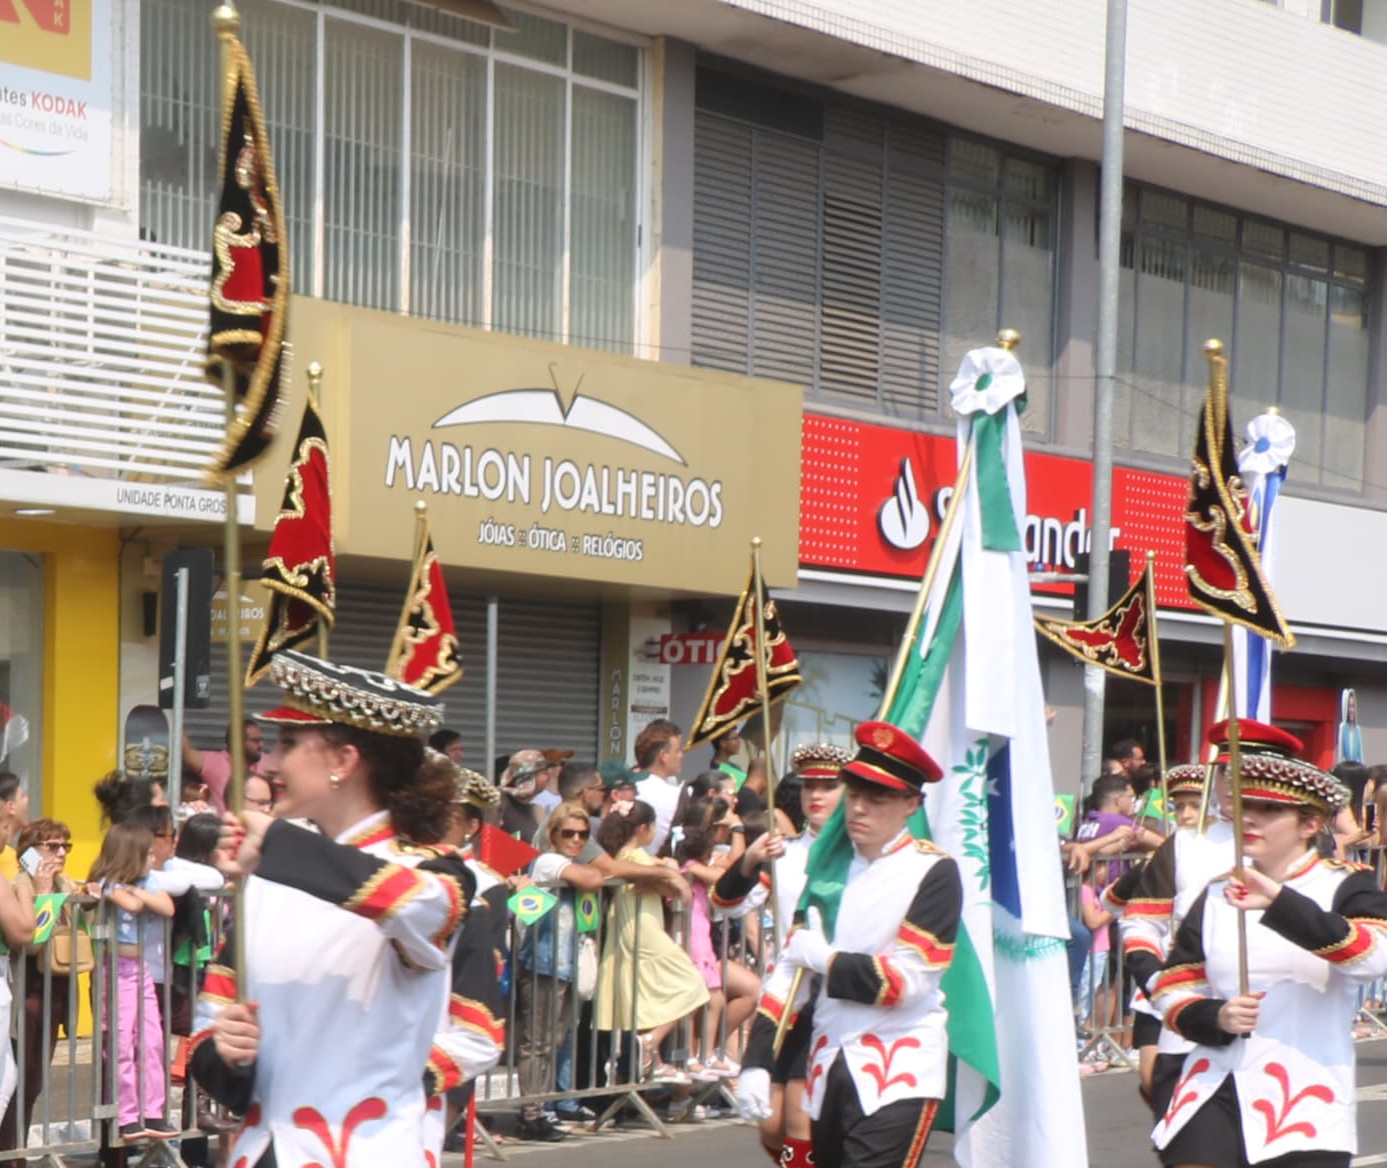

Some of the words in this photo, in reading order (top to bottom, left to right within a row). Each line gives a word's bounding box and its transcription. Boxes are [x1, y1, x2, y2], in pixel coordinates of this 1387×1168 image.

[30, 90, 88, 121] KODAK
[116, 487, 161, 508] UNIDADE
[163, 492, 196, 511] PONTA
[198, 496, 228, 514] GROS
[384, 434, 531, 505] MARLON
[540, 456, 724, 530] JOALHEIROS
[477, 516, 515, 547] JÓIAS
[528, 521, 566, 552] ÓTICA
[582, 530, 644, 561] RELÓGIOS
[610, 668, 622, 754] MARLON
